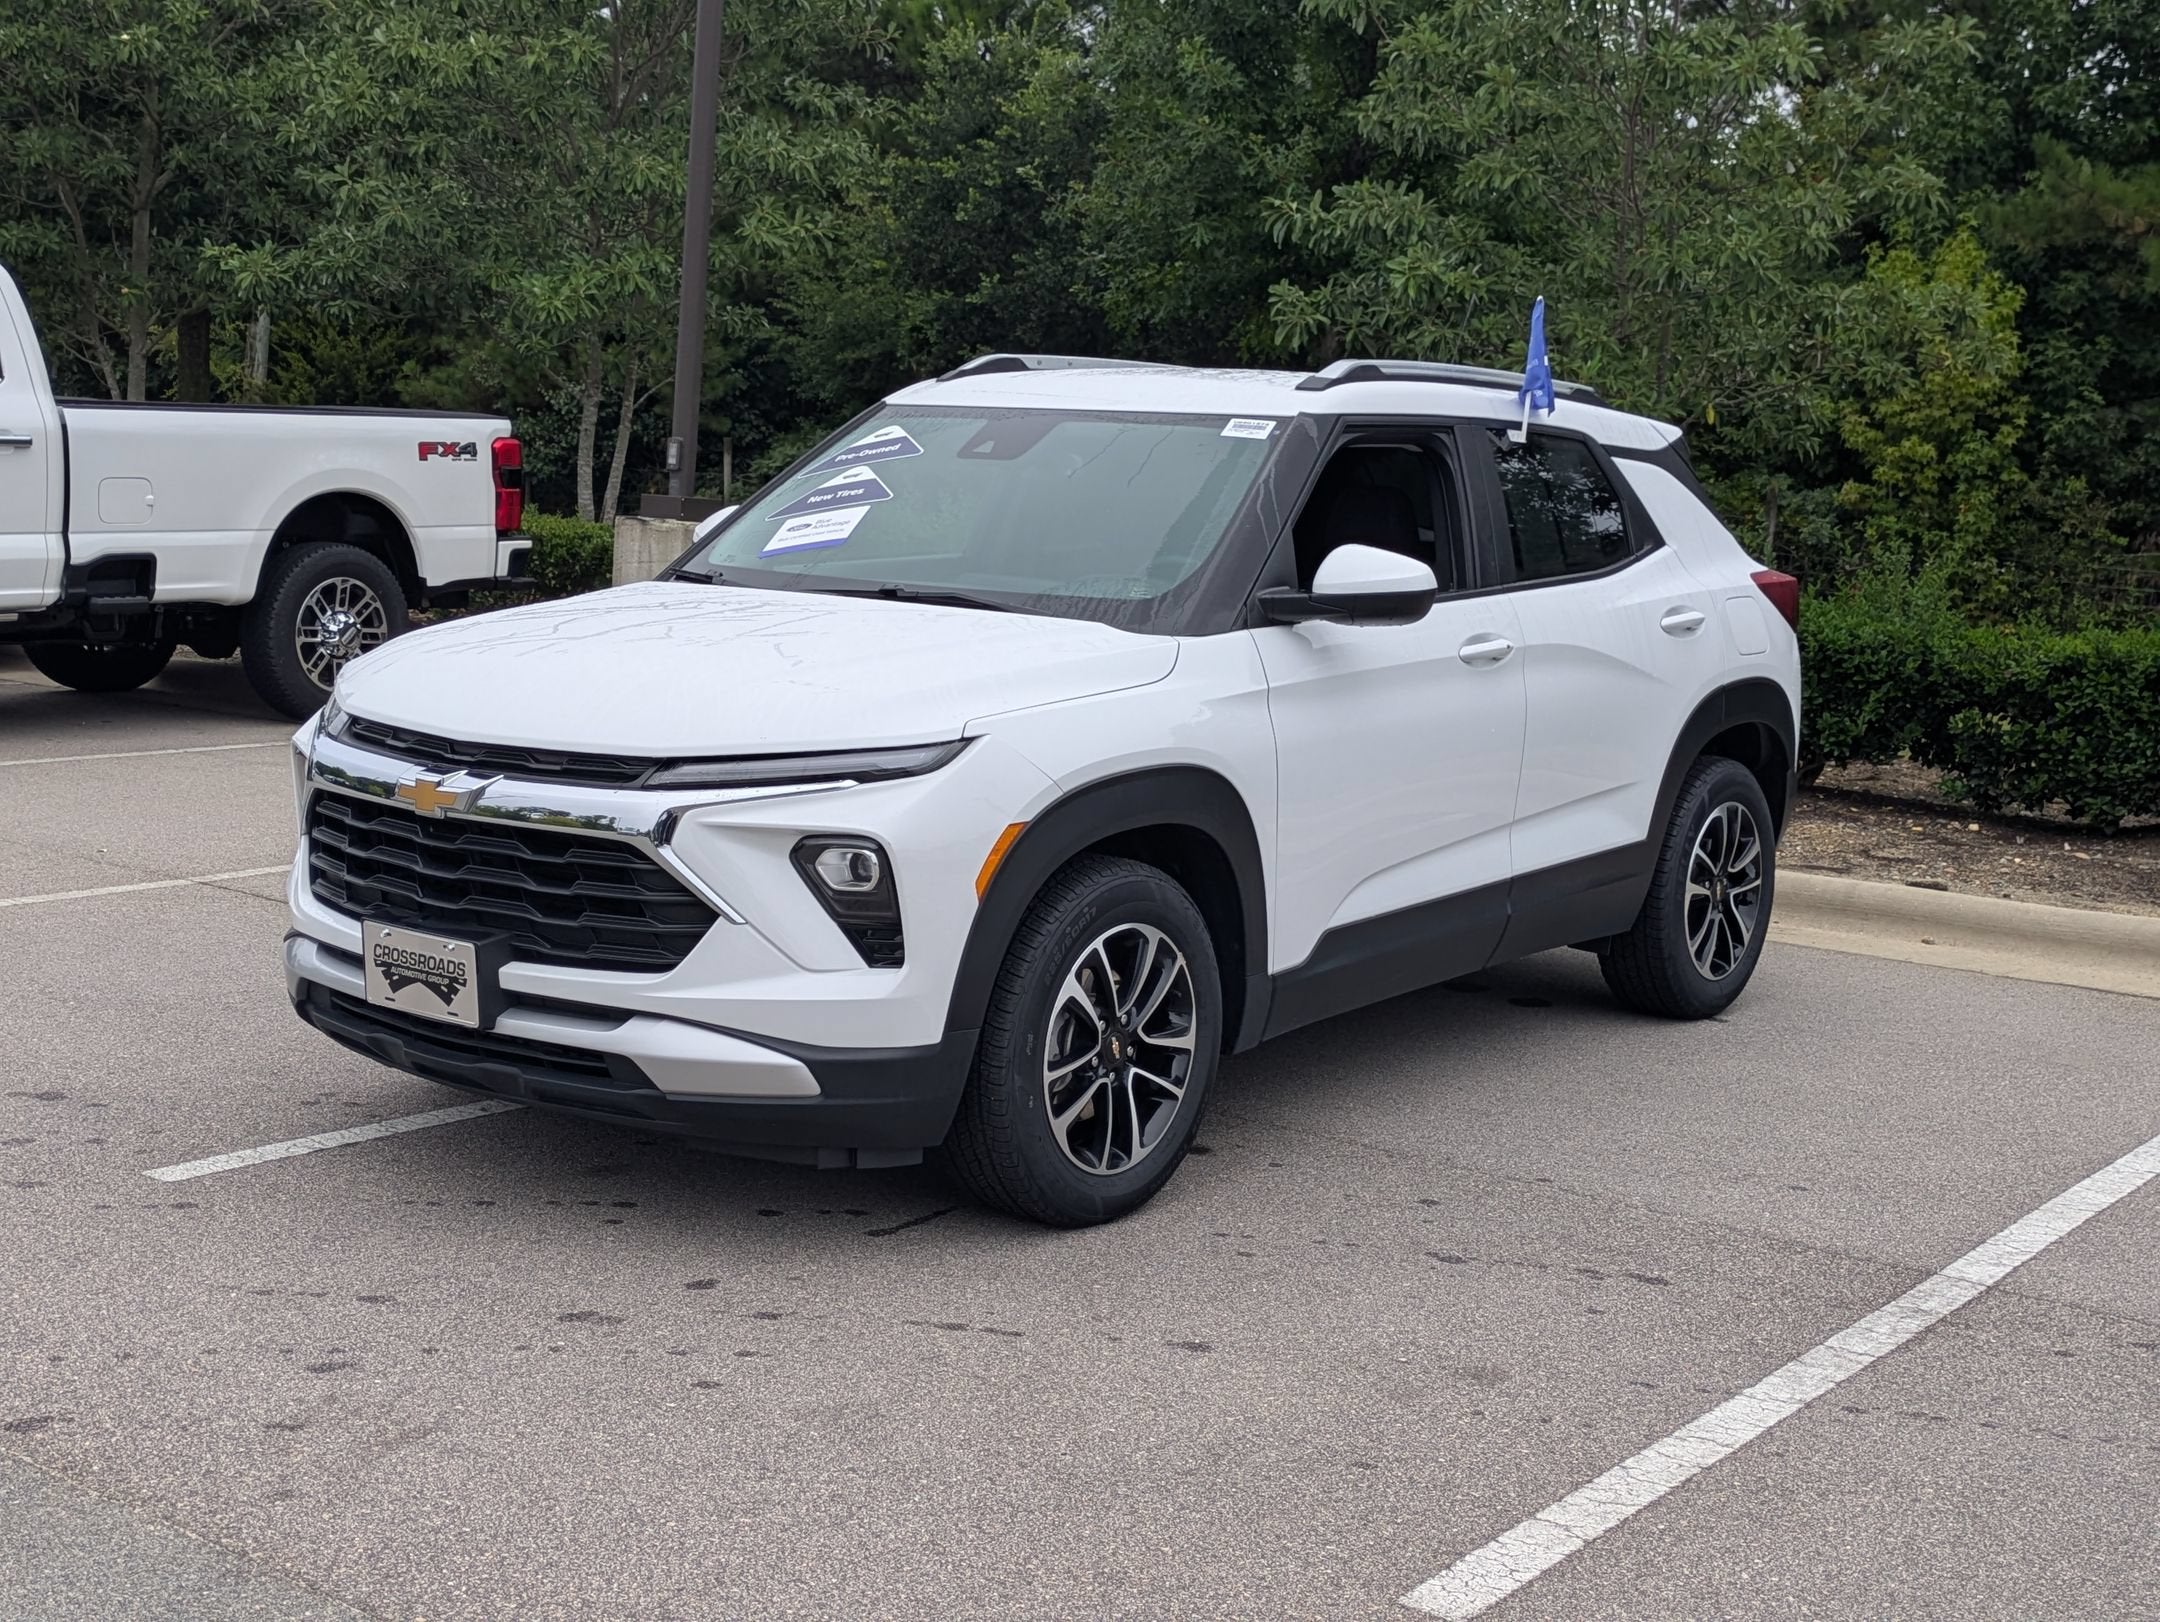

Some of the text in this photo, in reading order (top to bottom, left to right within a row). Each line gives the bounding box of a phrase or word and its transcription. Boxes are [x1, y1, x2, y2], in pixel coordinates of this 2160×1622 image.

[418, 442, 477, 461] FX4
[835, 443, 902, 462] Pre-Owned
[807, 488, 865, 504] New Tires
[373, 943, 467, 977] CROSSROADS
[391, 966, 450, 985] AUTOMOTIVE GROUP
